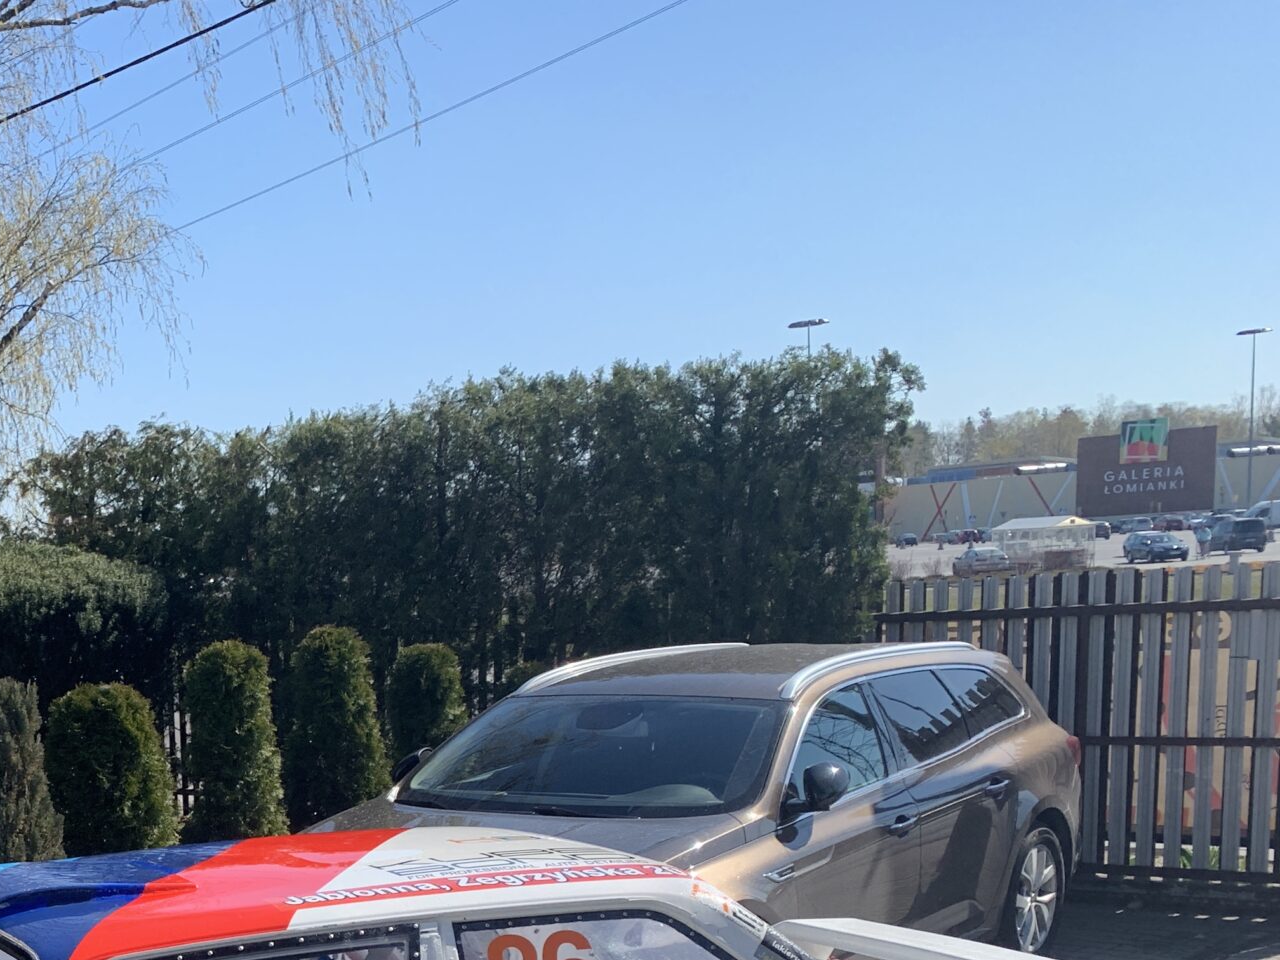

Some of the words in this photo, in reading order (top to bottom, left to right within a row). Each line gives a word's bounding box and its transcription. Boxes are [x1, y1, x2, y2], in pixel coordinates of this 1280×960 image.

[1103, 465, 1185, 482] GALERIA
[1103, 479, 1185, 495] ŁOMIANKI
[441, 863, 537, 877] PROFESSIONAL
[448, 864, 644, 889] Zegrzyńska
